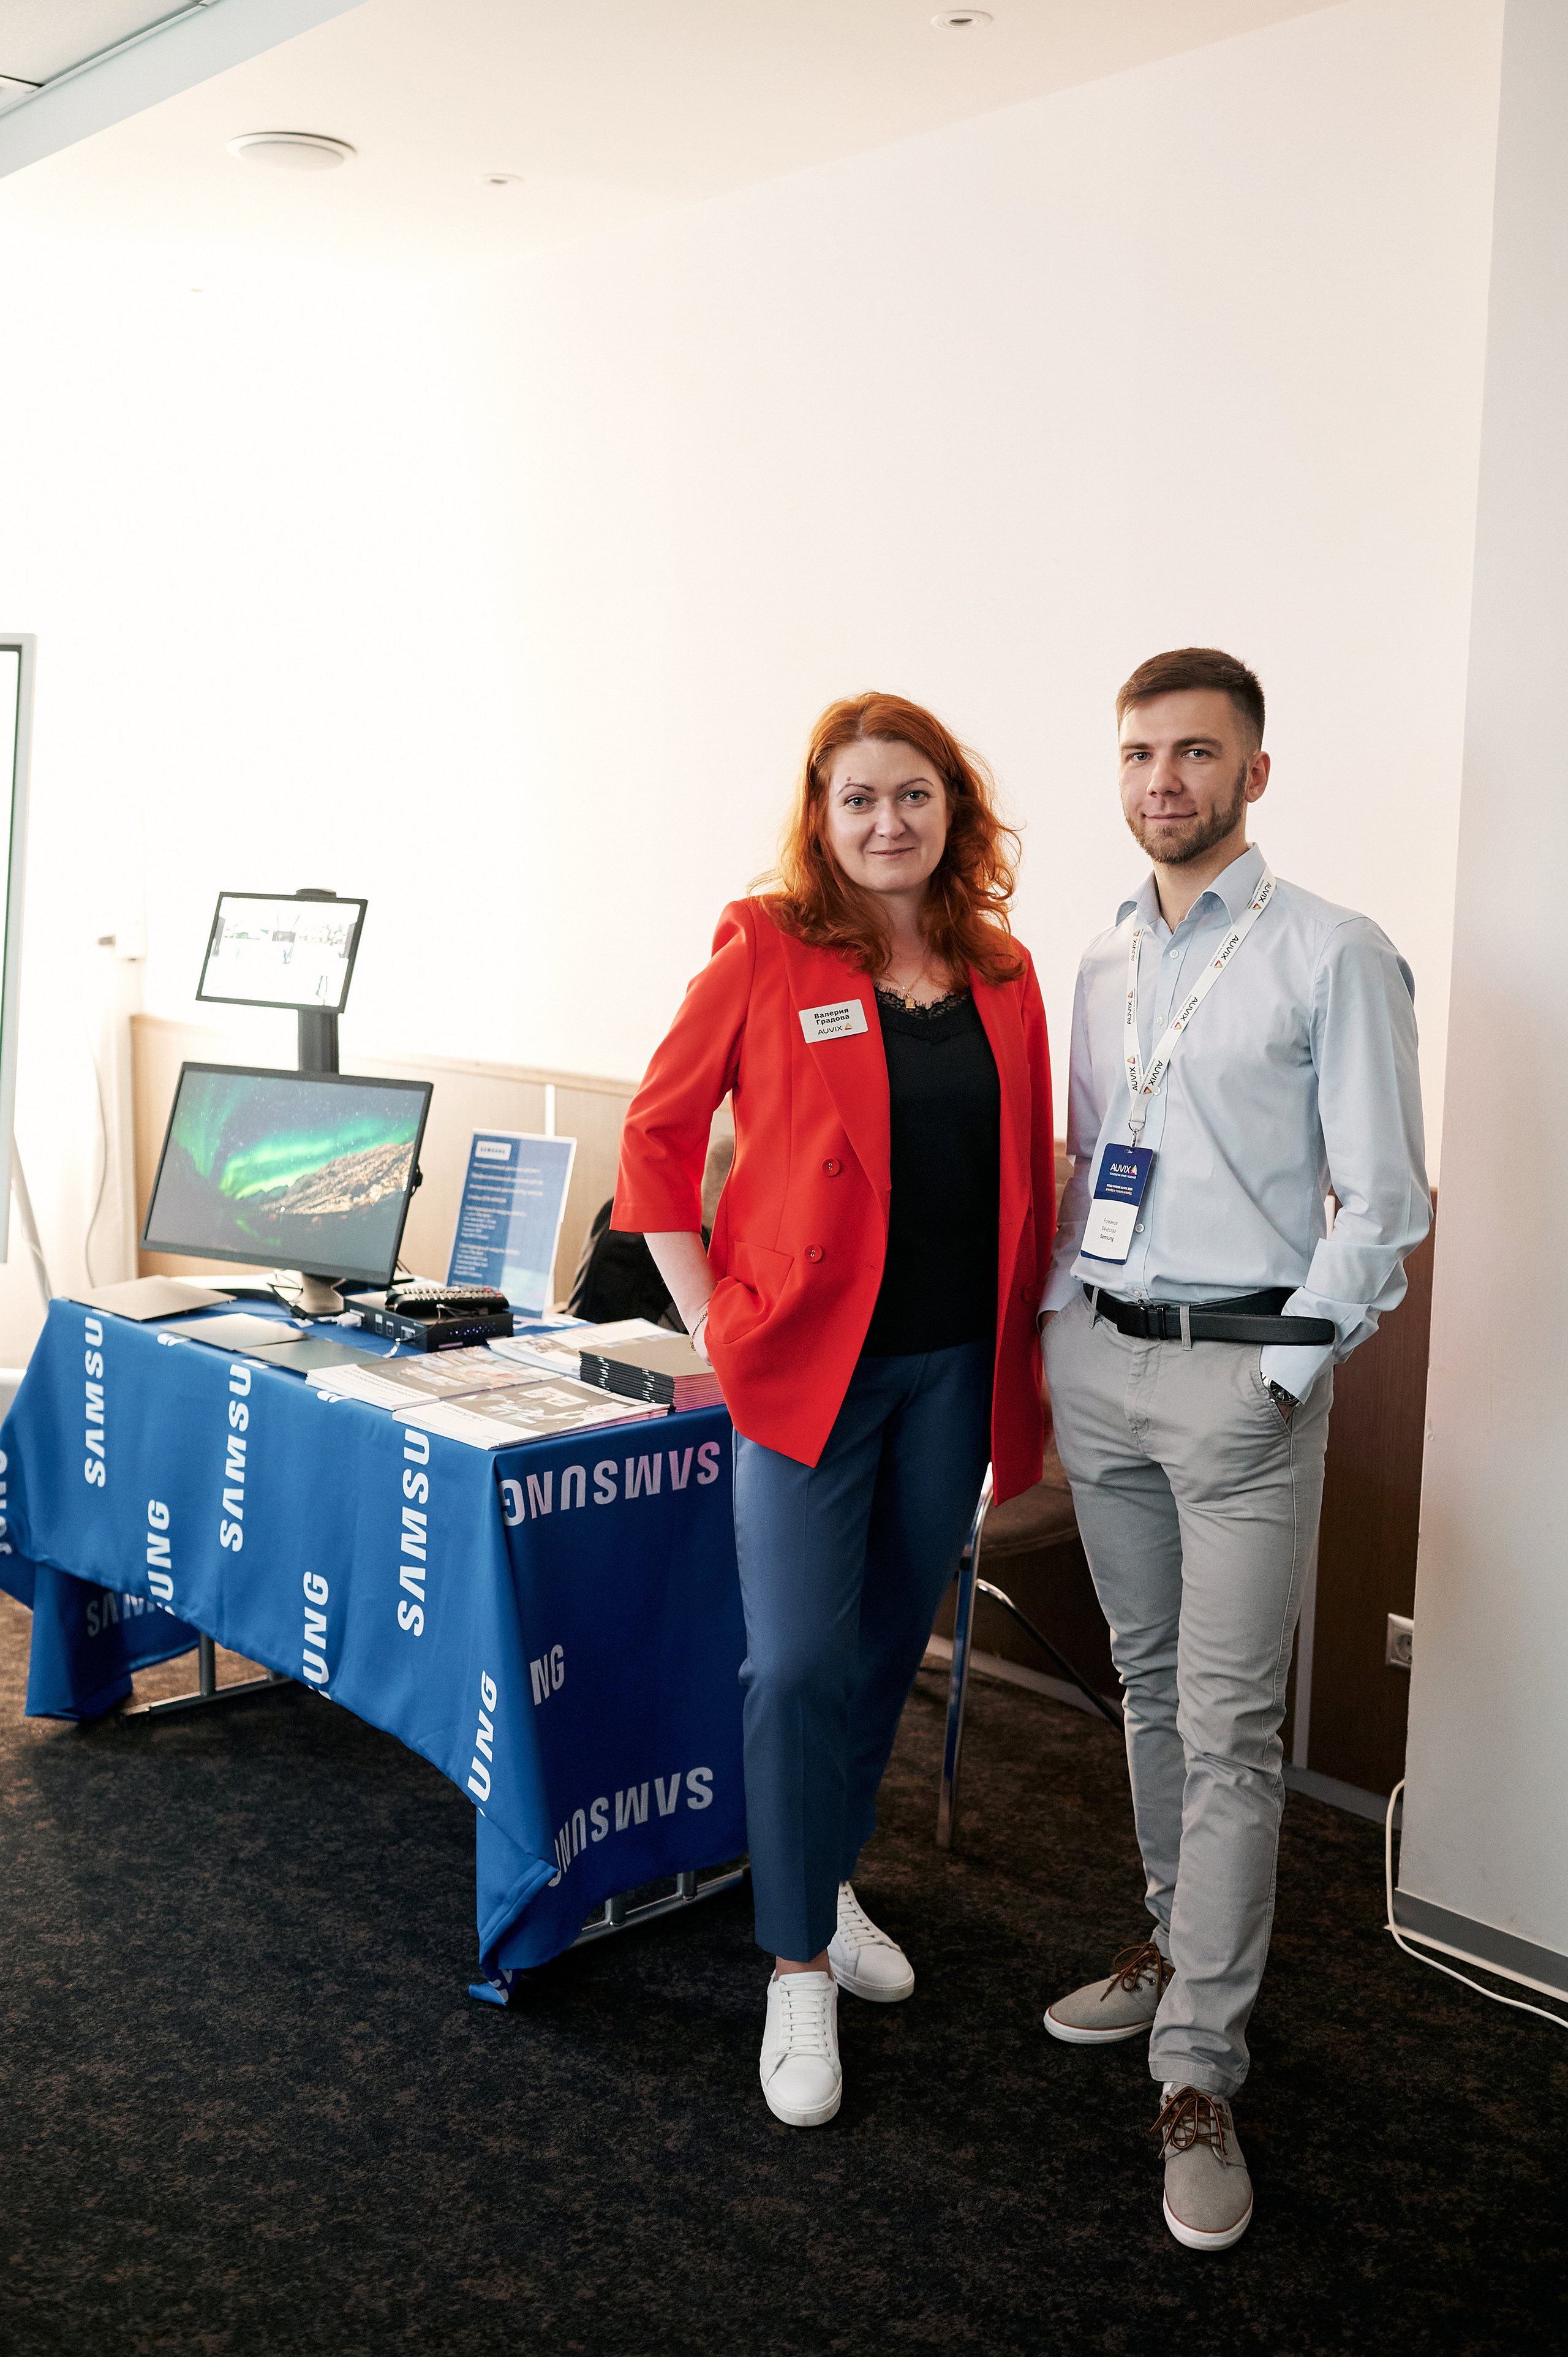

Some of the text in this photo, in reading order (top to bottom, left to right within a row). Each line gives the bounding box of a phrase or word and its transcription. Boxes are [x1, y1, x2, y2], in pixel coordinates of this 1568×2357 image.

[1258, 882, 1272, 902] AUVIX
[1221, 935, 1239, 960] AUVIX
[814, 1008, 849, 1019] Валерия
[816, 1015, 850, 1025] Градова
[1180, 996, 1198, 1021] AUVIX
[818, 1026, 843, 1035] AUVIX
[1129, 1066, 1138, 1091] AUVIX
[1148, 1060, 1163, 1086] AUVIX
[1110, 1163, 1131, 1173] AUVIX
[1099, 1233, 1114, 1242] Samsung
[85, 1311, 107, 1488] SAMSU
[219, 1361, 255, 1552] SAMSU
[498, 1441, 720, 1527] SAMSUNG
[398, 1428, 430, 1637] SAMSU
[146, 1499, 175, 1615] UNG
[86, 1592, 156, 1637] SAM
[303, 1571, 331, 1697] UNG
[529, 1644, 565, 1706] NG
[466, 1670, 497, 1815] UNG
